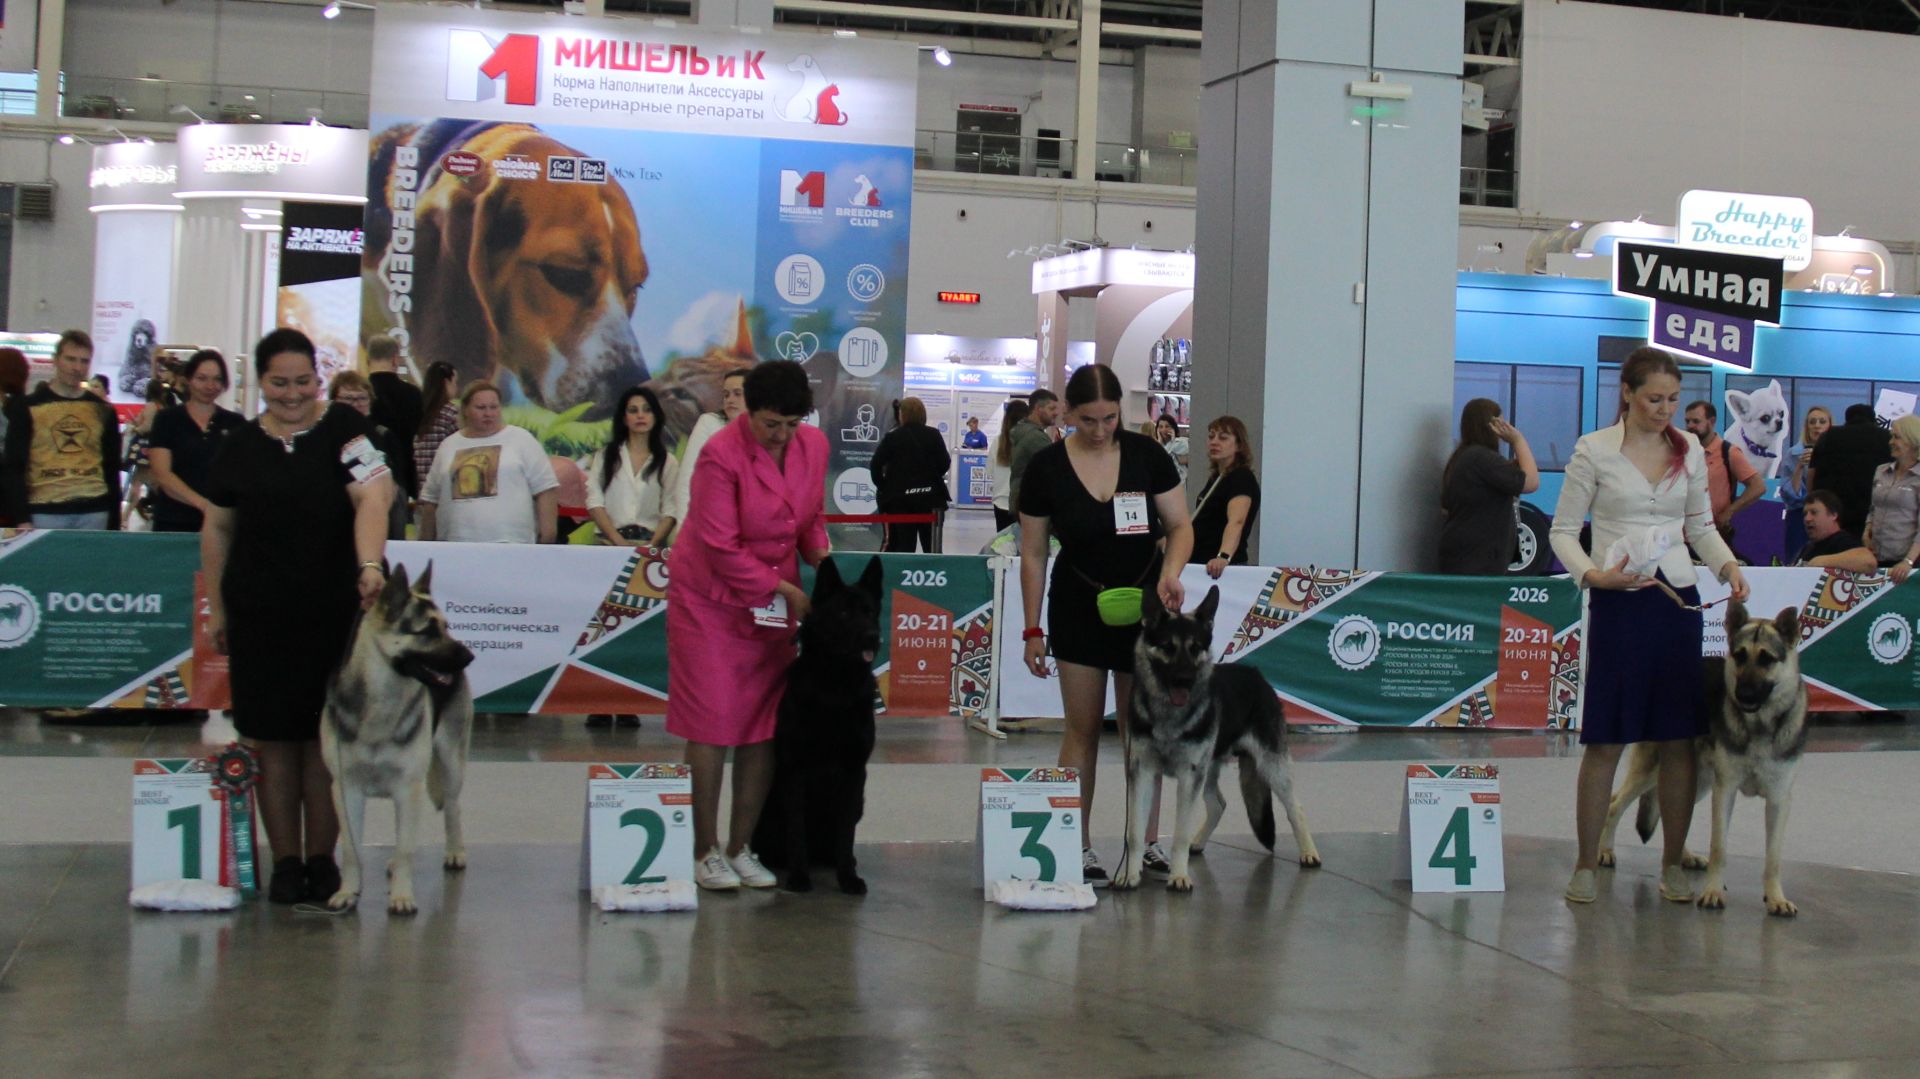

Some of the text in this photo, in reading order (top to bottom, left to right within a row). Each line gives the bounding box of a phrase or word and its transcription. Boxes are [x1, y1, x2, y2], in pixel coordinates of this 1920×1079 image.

[554, 37, 765, 79] МИШЕЛЬ и К
[554, 73, 763, 101] Корма Наполнители Аксессуары
[552, 93, 764, 120] Ветеринарные препараты
[835, 207, 894, 219] BREEDERS
[1715, 199, 1806, 233] Happy
[388, 146, 418, 313] BREEDERS
[849, 218, 879, 227] CLUB
[285, 241, 363, 254] НА АКТИВНОСТЬ
[1632, 251, 1770, 308] Умная
[940, 293, 978, 303] ТУАЛЕТ
[1666, 312, 1740, 353] еда
[1125, 511, 1137, 521] 14
[901, 569, 948, 587] 2026
[47, 591, 162, 613] РОССИЯ
[1508, 586, 1549, 603] 2026
[446, 601, 528, 615] Российская
[765, 602, 775, 611] 2
[446, 621, 560, 633] кинологическая
[897, 613, 947, 631] 20-21
[1387, 621, 1475, 641] РОССИЯ
[898, 637, 946, 649] ИЮНЯ
[1504, 628, 1548, 644] 20-21
[1505, 649, 1547, 660] ИЮНЯ
[168, 804, 202, 879] 1
[620, 808, 667, 885] 2
[1011, 812, 1056, 882] 3
[1428, 807, 1477, 885] 4
